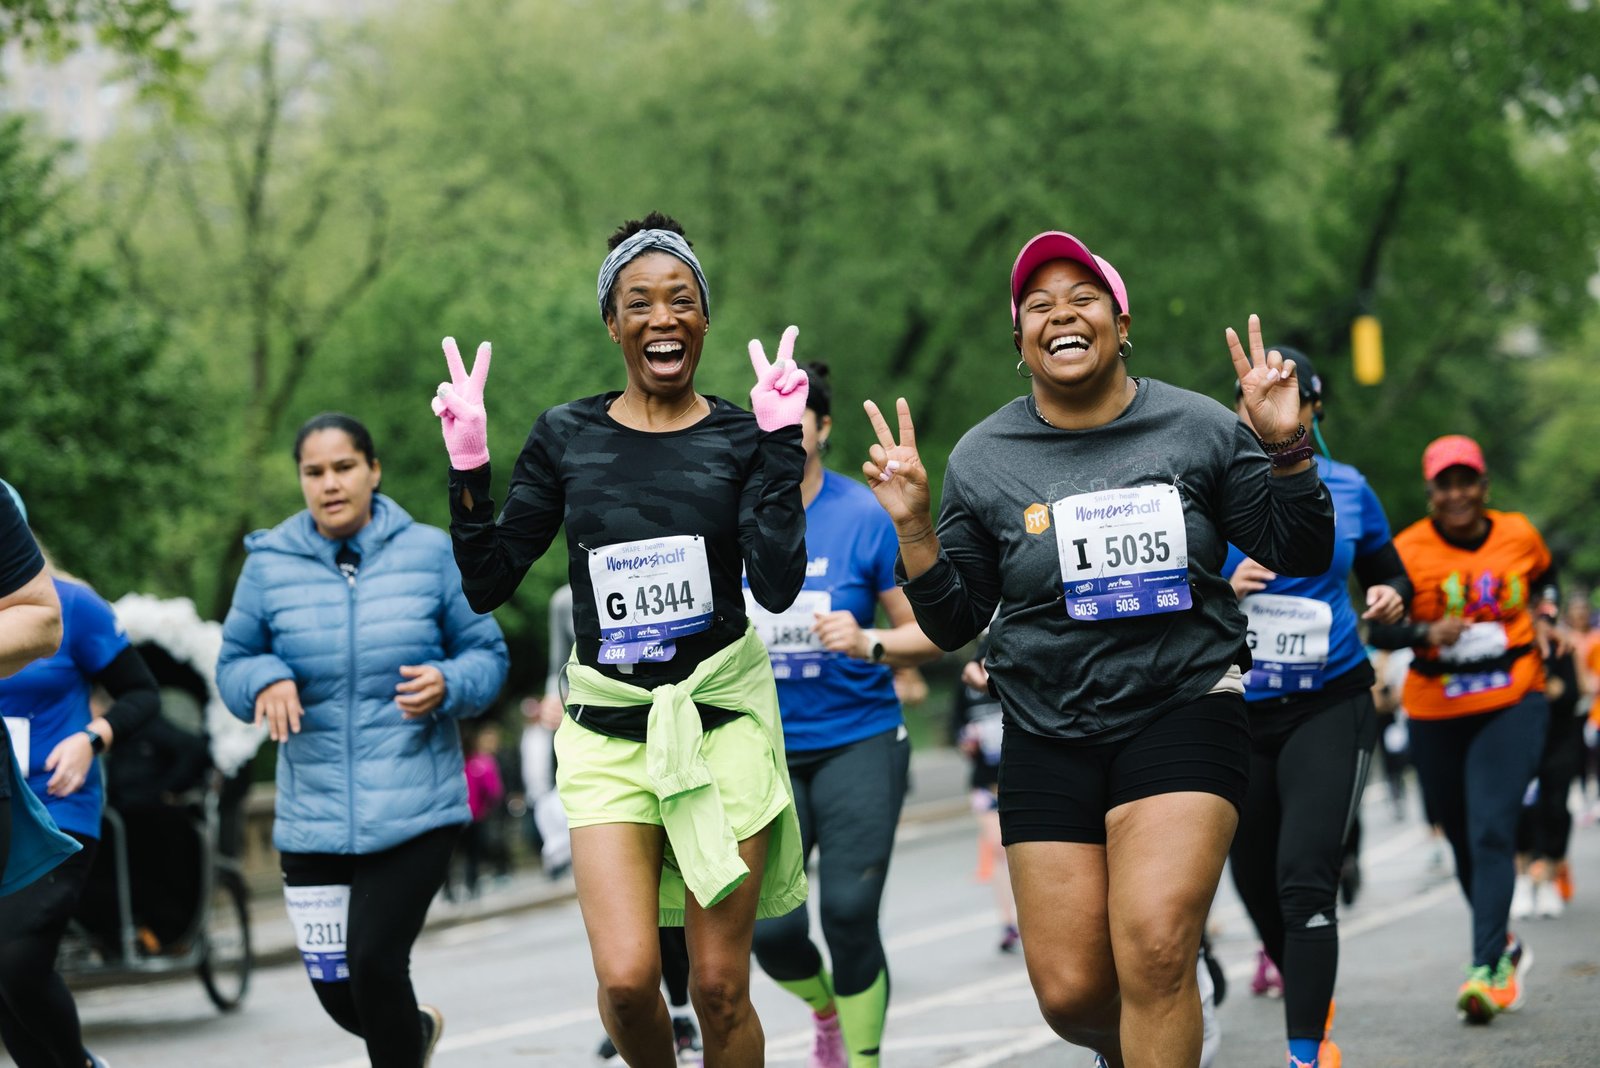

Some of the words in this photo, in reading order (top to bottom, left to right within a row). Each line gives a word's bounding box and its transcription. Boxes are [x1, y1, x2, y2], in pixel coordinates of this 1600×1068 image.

[1119, 492, 1139, 500] health
[645, 542, 665, 551] health
[1072, 538, 1092, 570] I
[1105, 531, 1170, 568] 5035
[606, 592, 628, 620] G
[635, 580, 695, 617] 4344
[1116, 598, 1140, 612] 5035
[1157, 593, 1180, 607] 5035
[1074, 602, 1098, 616] 5035
[643, 645, 664, 658] 4344
[1276, 633, 1307, 656] 971
[605, 648, 626, 660] 4344
[304, 923, 346, 946] 2311
